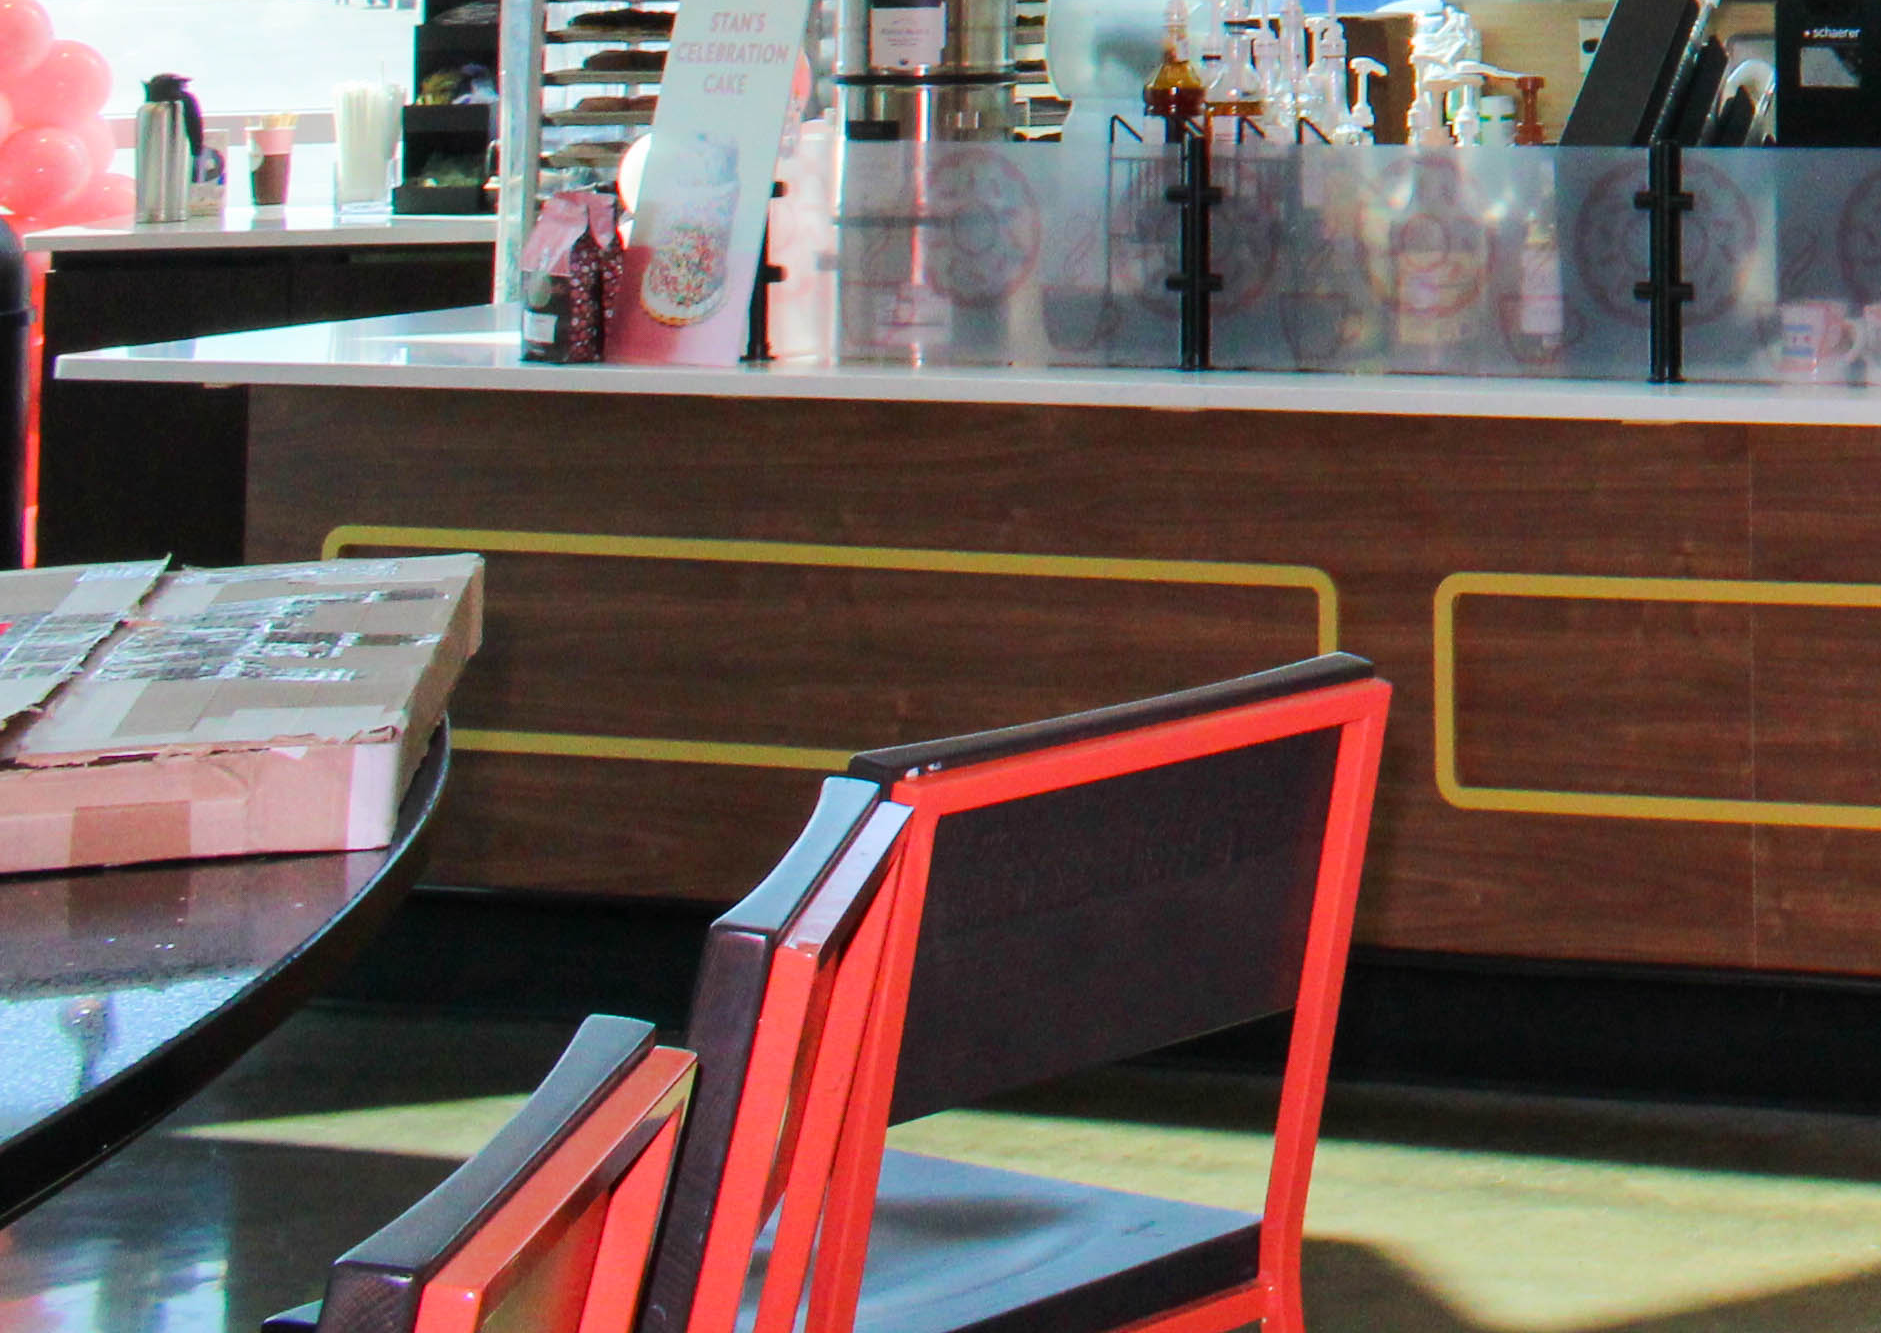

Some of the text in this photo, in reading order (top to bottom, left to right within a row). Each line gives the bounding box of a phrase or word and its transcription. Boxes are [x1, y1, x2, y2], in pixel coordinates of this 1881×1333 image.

[711, 12, 766, 33] STAN'S
[1813, 26, 1861, 39] schaerer
[676, 42, 789, 64] CELEBRATION
[703, 74, 748, 94] CAKE
